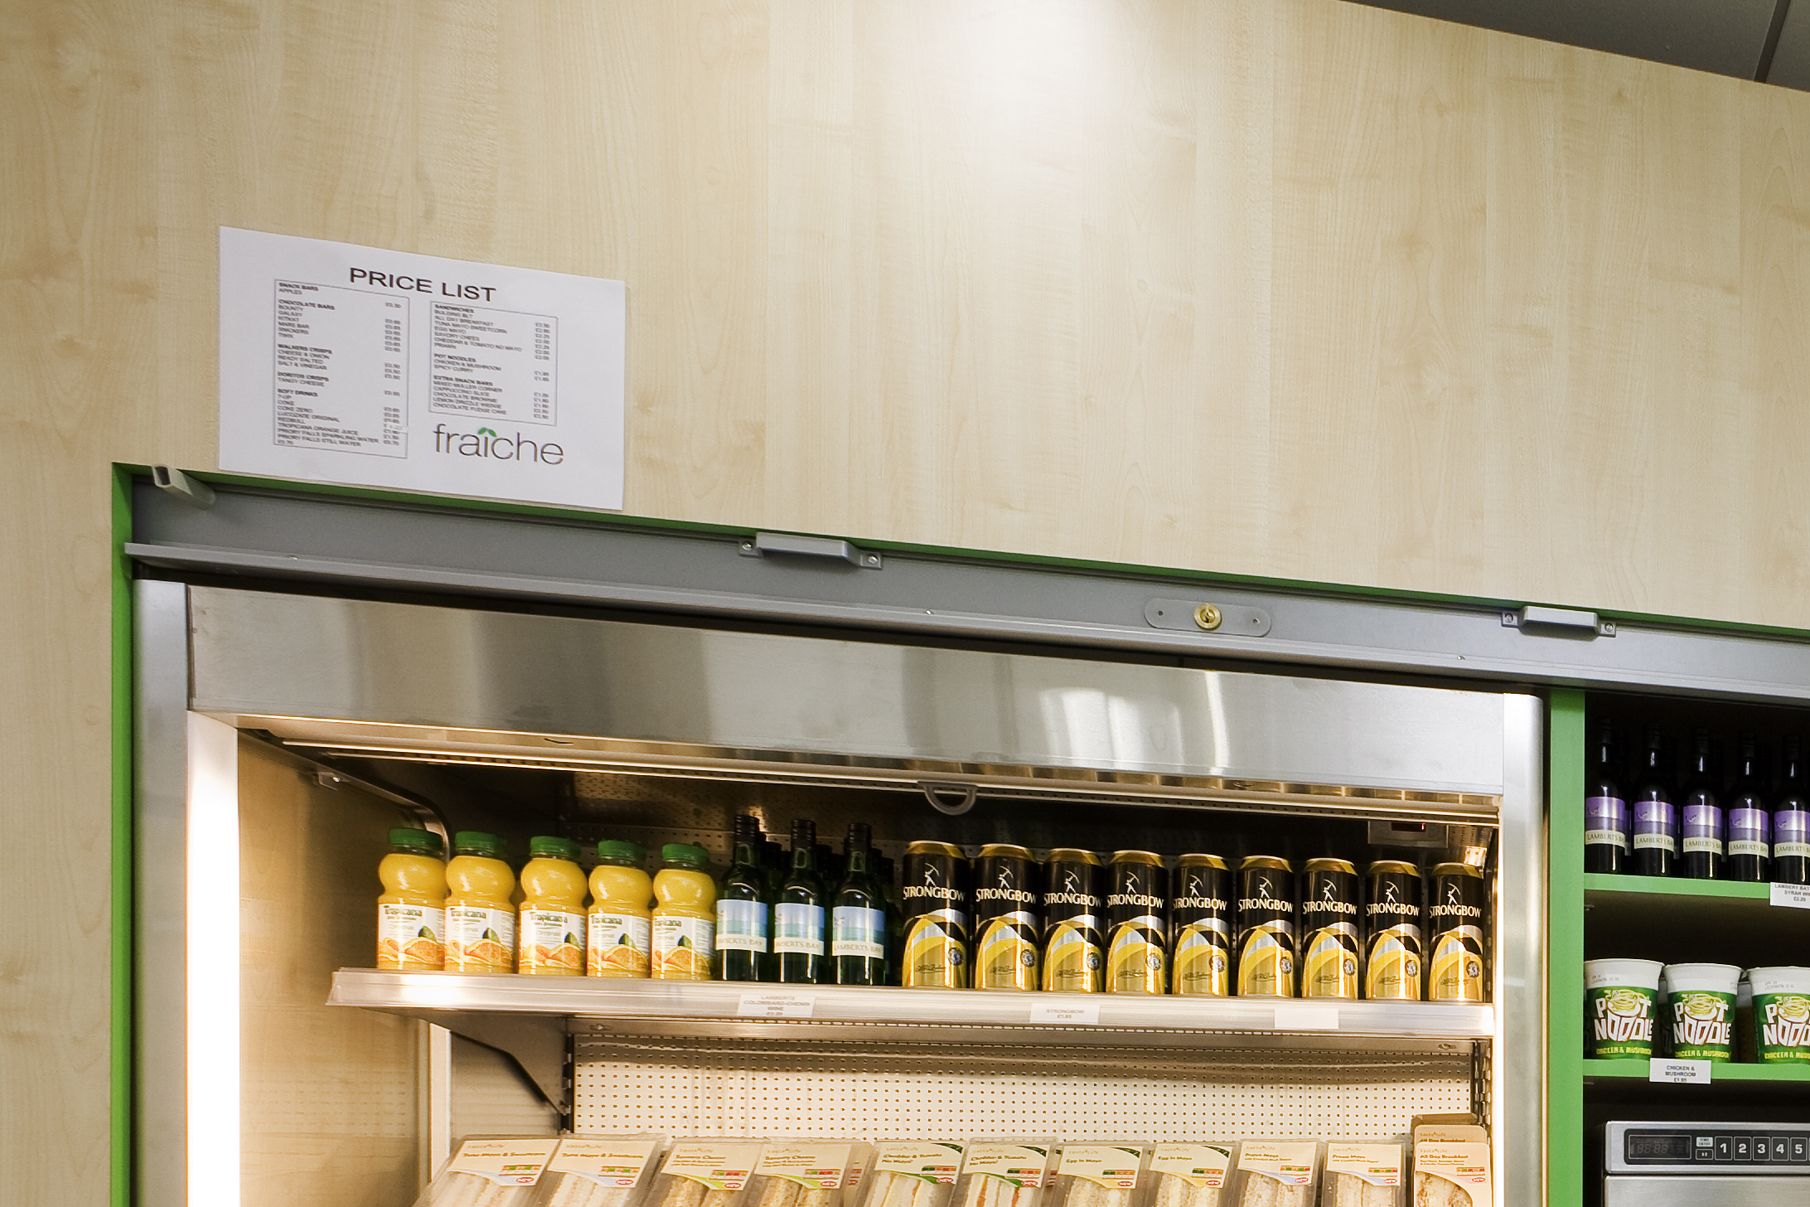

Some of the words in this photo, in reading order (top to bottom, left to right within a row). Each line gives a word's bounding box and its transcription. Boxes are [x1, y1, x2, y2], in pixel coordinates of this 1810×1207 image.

[350, 267, 433, 294] PRICE
[442, 282, 497, 302] LIST
[903, 886, 965, 901] STRONGBOW
[976, 885, 1036, 904] STRONGBOW
[1043, 892, 1101, 907] STRONGBOW
[1107, 893, 1164, 909] STRONGBOW
[1172, 898, 1227, 912] STRONGBOW
[1238, 899, 1294, 913] STRONGBOW
[1303, 901, 1357, 915] STRONGBOW
[1366, 903, 1420, 917] STRONGBOW
[1429, 905, 1482, 919] STRONGBOW
[1595, 998, 1652, 1018] POT
[1674, 1002, 1729, 1021] POT
[1594, 1015, 1653, 1042] NOODLE
[1673, 1016, 1732, 1045] NOODLE
[1720, 1143, 1727, 1154] 1
[1738, 1143, 1747, 1154] 2
[1757, 1143, 1766, 1154] 3
[1776, 1143, 1785, 1154] 4
[1795, 1144, 1803, 1154] 5
